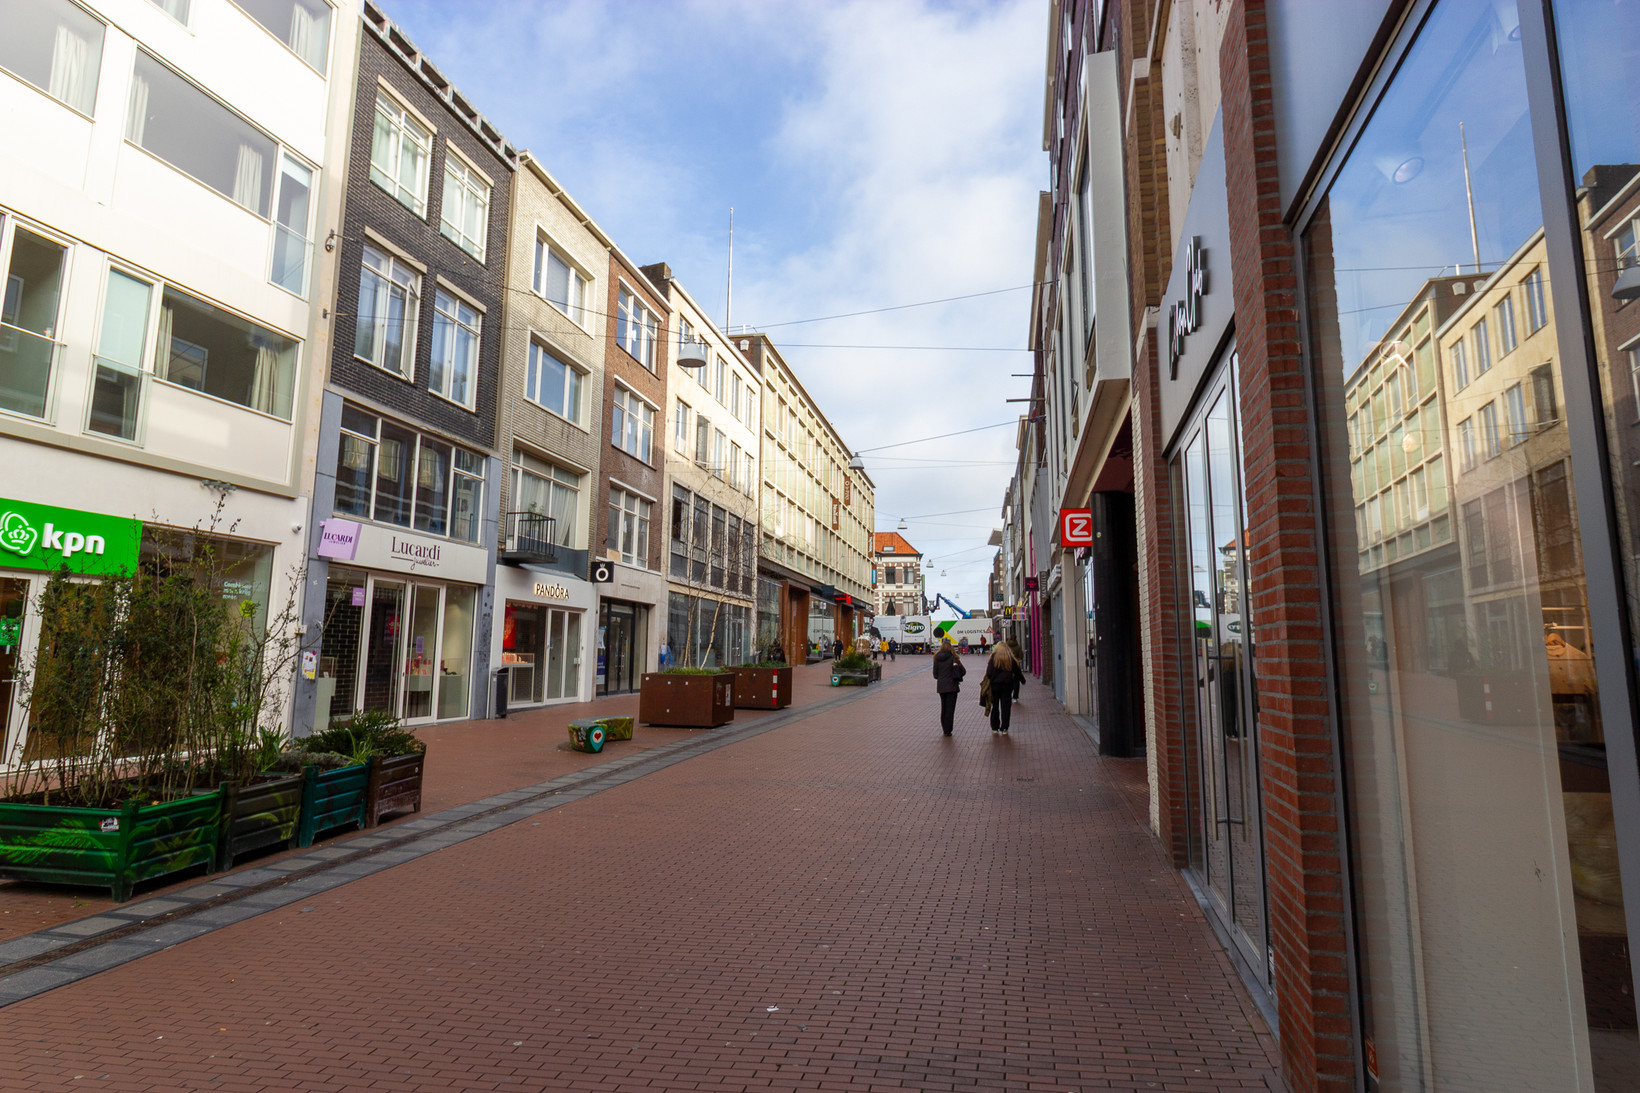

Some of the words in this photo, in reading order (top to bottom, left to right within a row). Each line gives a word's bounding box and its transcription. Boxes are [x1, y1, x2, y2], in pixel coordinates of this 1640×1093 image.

[41, 522, 105, 558] kpn
[324, 532, 354, 544] LUCARDI
[391, 536, 441, 560] Lucardi
[536, 583, 570, 600] PANDORA
